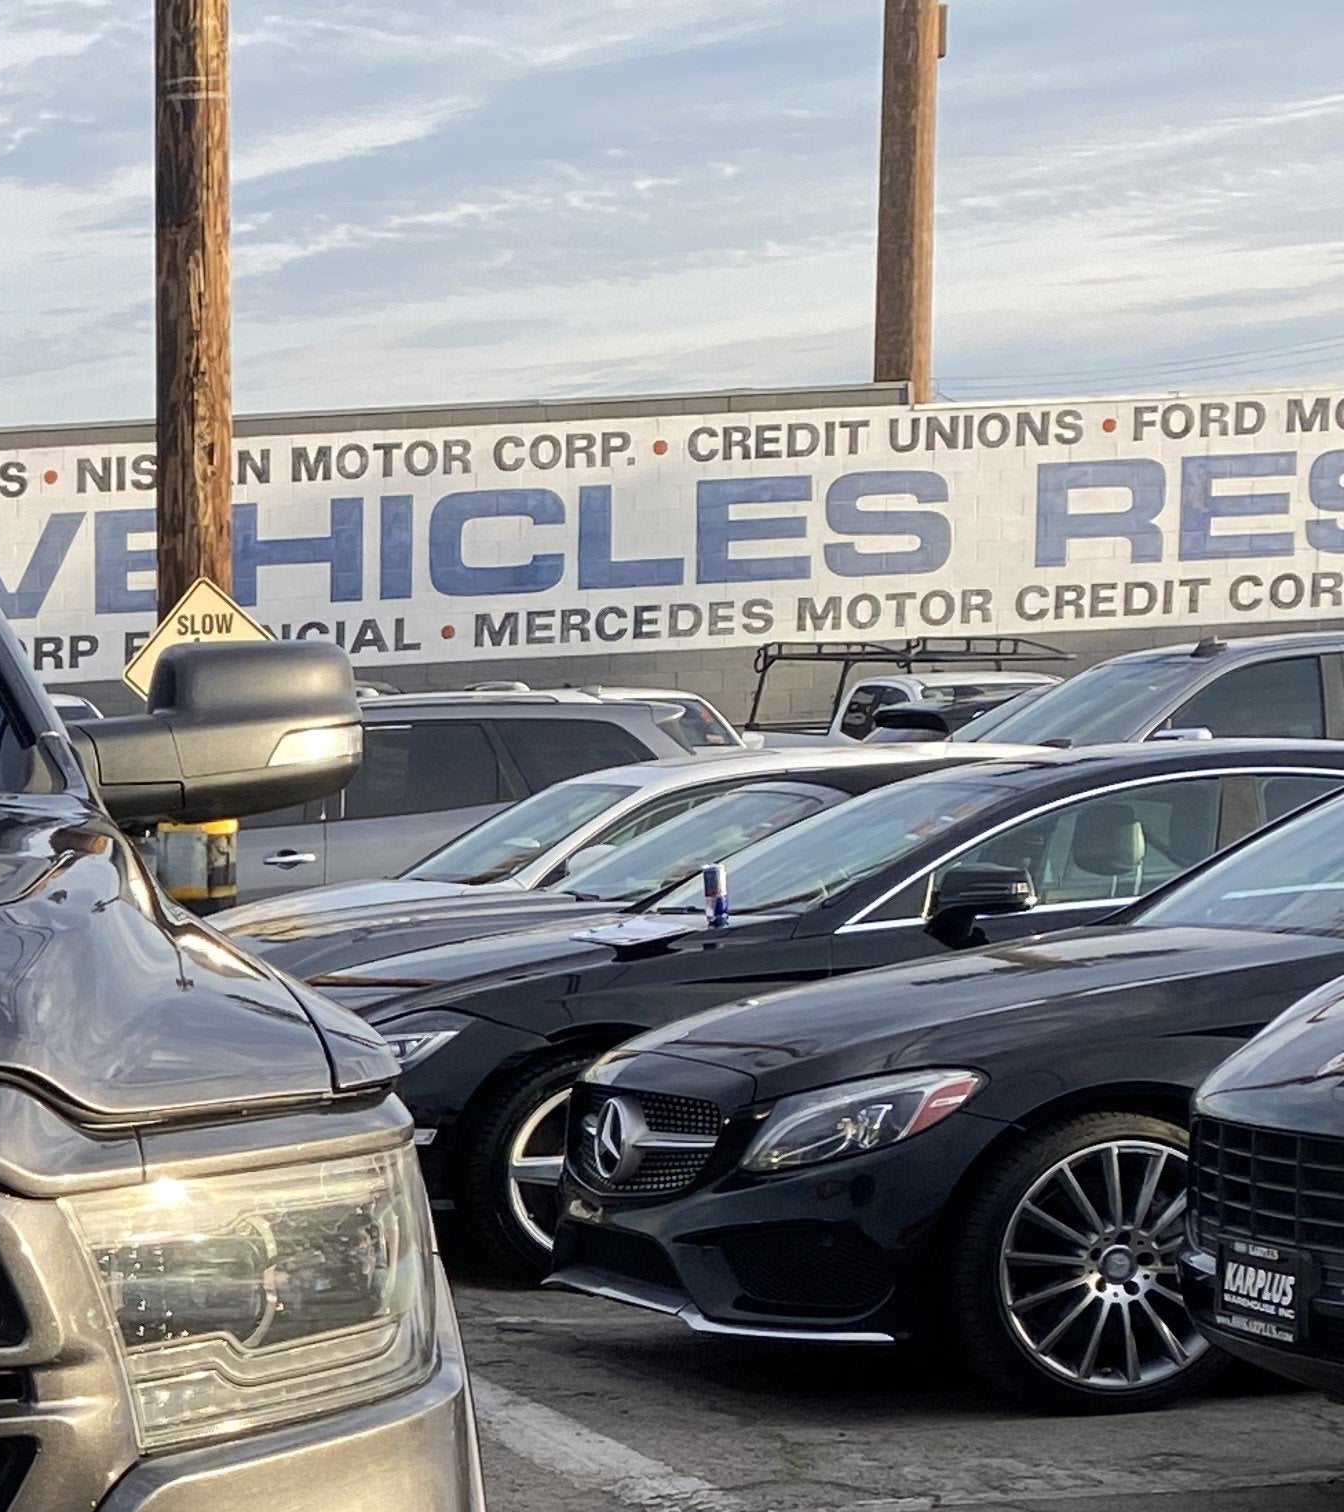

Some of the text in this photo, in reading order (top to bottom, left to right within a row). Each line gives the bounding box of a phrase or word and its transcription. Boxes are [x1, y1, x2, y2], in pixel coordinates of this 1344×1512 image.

[76, 448, 272, 495] NISN
[291, 438, 472, 482] MOTOR
[492, 431, 637, 472] CORP.
[687, 419, 870, 462] CREDIT
[889, 408, 1084, 454] UNIONS
[1132, 400, 1267, 442] FORD
[23, 634, 100, 672] RP
[473, 598, 774, 648] MERCEDES
[796, 587, 994, 634] MOTOR
[1015, 576, 1211, 623] CREDIT
[176, 612, 235, 636] SLOW
[1223, 1261, 1296, 1306] KARPLUS
